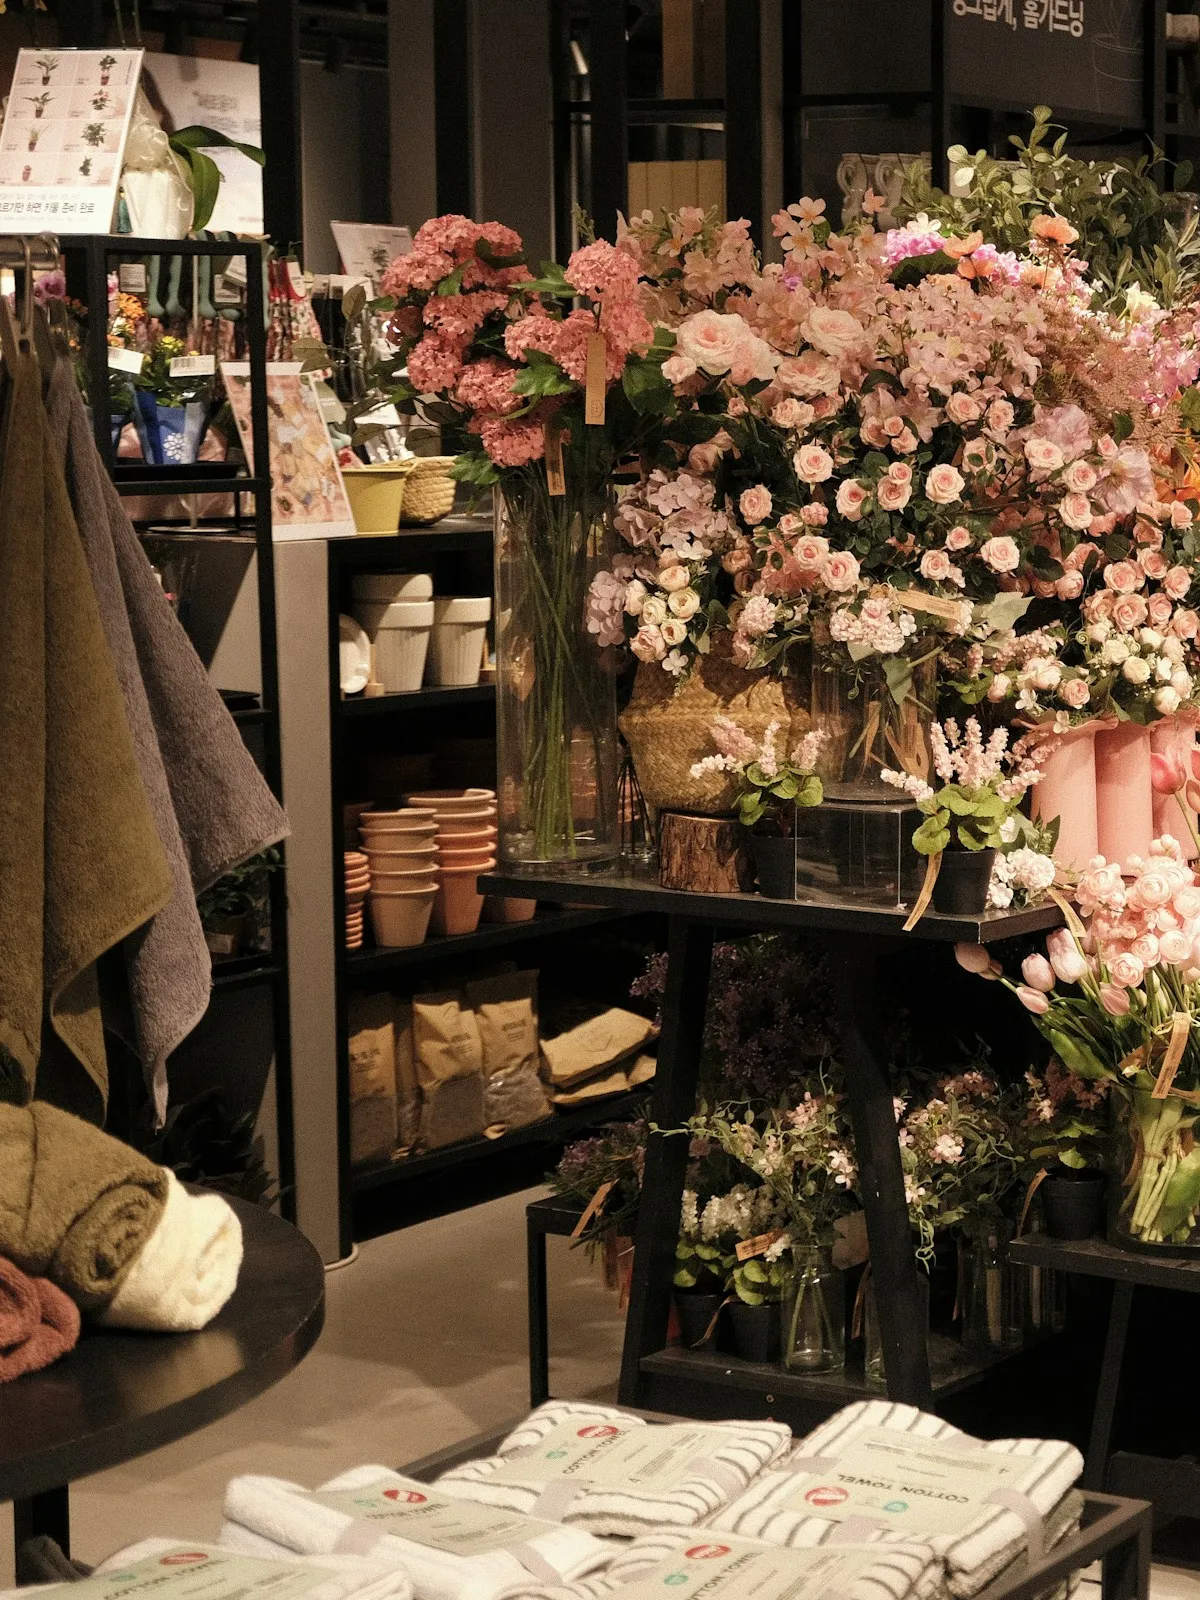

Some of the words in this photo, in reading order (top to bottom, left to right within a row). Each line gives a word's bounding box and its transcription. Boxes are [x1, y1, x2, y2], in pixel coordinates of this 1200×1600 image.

[1023, 0, 1083, 37] 홈가드닝
[26, 202, 41, 213] 하면
[61, 202, 76, 213] 준비
[79, 202, 94, 213] 완료
[563, 1450, 600, 1474] COTTON
[837, 1474, 893, 1490] TOWEL
[901, 1486, 969, 1504] COTTON
[686, 1576, 725, 1600] TTON
[720, 1552, 763, 1573] TOWEL
